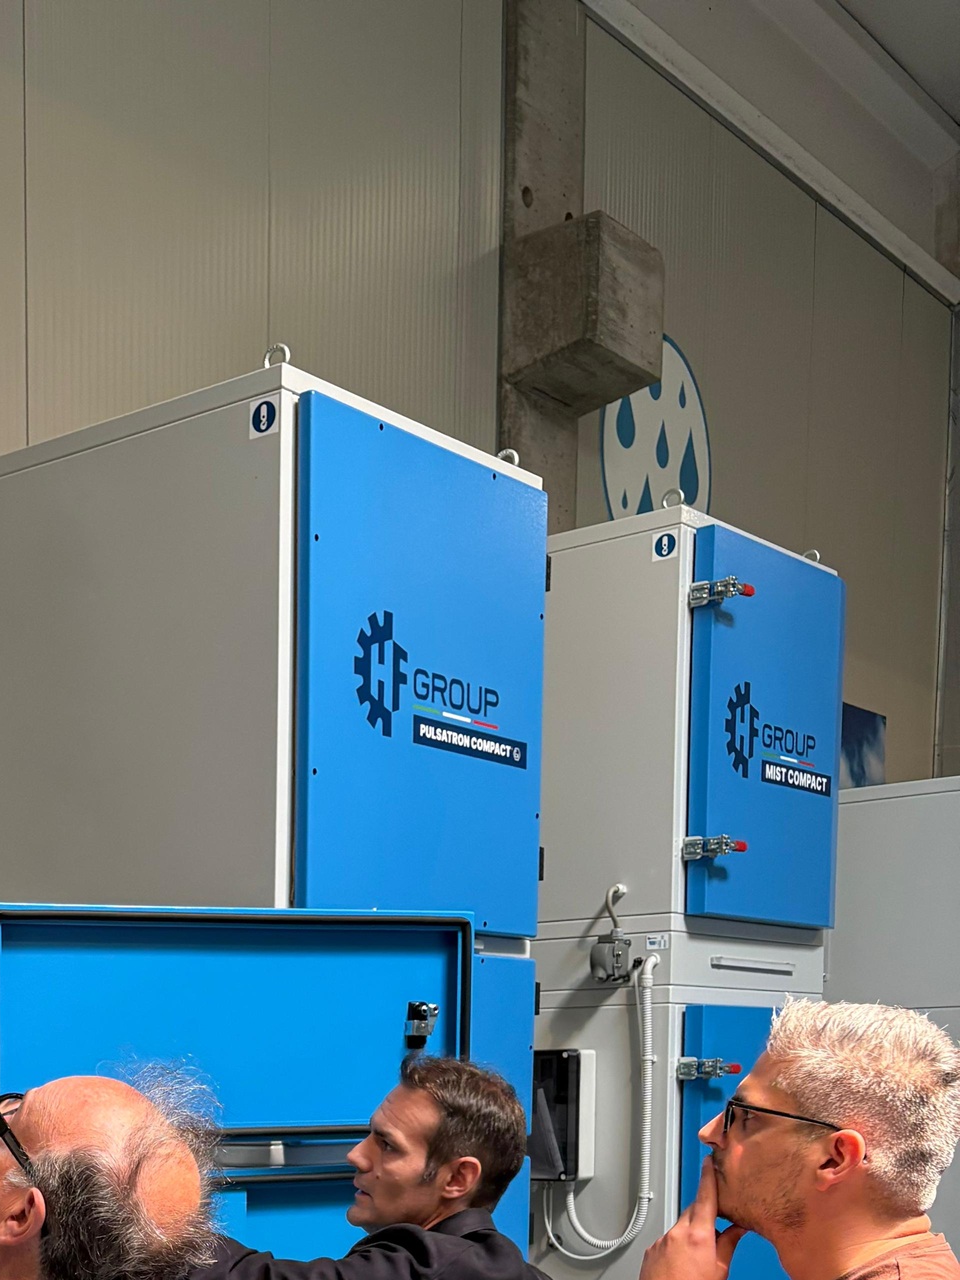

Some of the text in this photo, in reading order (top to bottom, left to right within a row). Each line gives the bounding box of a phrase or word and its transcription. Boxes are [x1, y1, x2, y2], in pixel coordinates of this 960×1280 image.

[413, 668, 500, 717] GROUP
[419, 723, 512, 758] PULSATRON COMPACT
[762, 723, 816, 758] GROUP
[765, 763, 828, 793] MIST COMPACT
